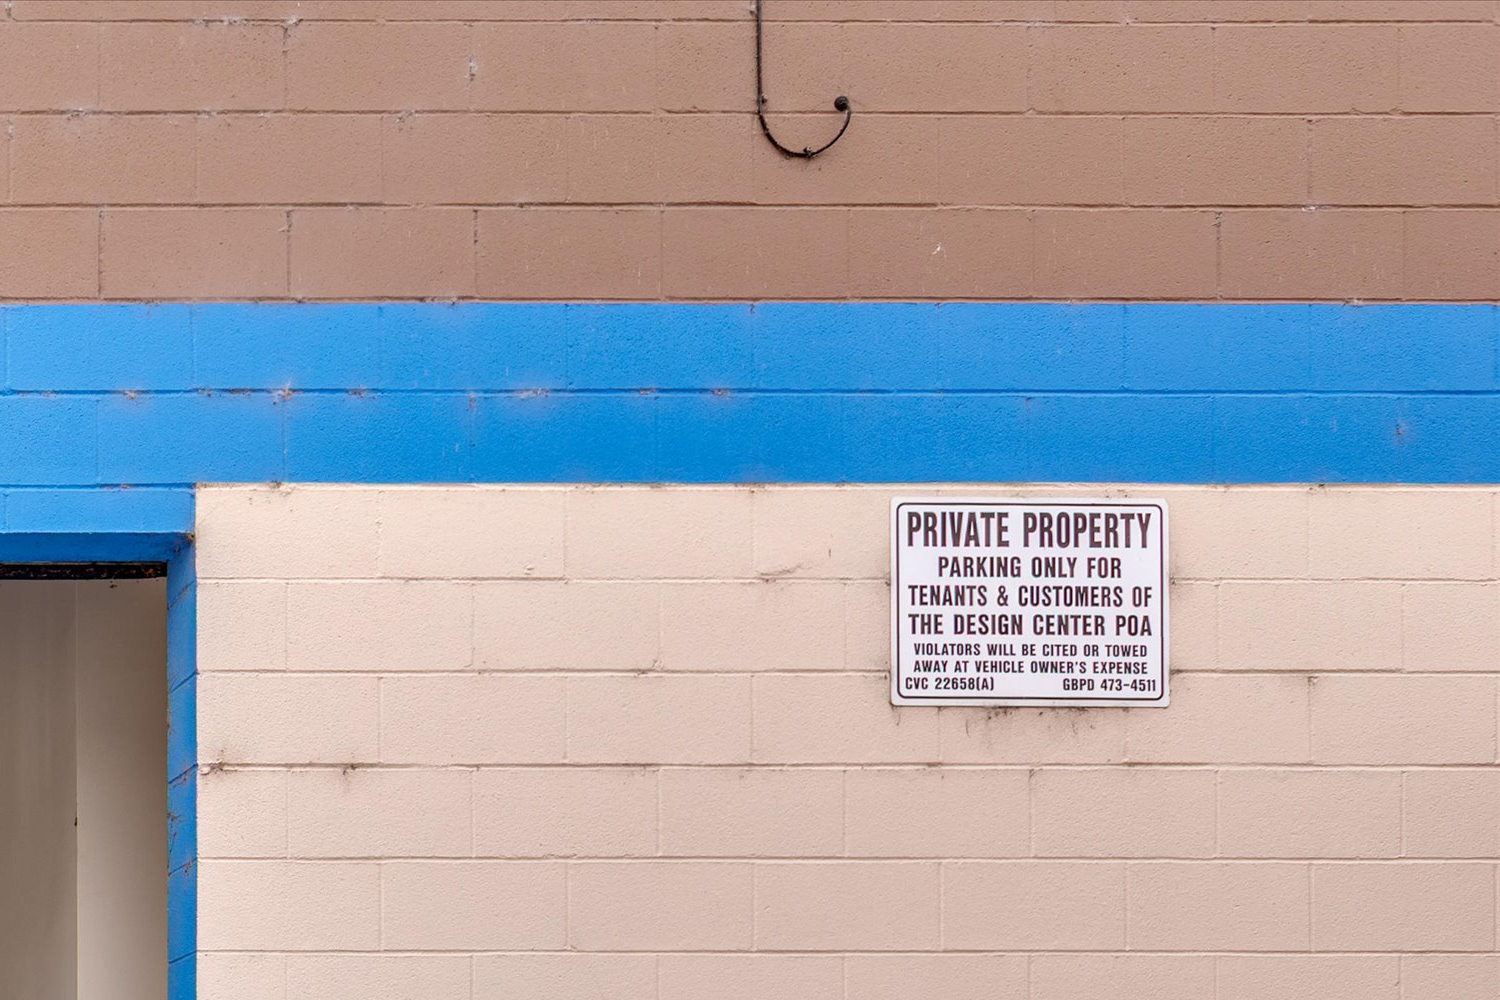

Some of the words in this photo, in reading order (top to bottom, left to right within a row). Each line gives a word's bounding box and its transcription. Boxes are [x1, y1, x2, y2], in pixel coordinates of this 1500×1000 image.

[908, 512, 1009, 547] PRIVATE
[1024, 512, 1151, 548] PROPERTY
[939, 557, 1020, 577] PARKING
[1032, 557, 1077, 577] ONLY
[1088, 557, 1121, 578] FOR
[908, 585, 987, 606] TENANTS
[997, 586, 1008, 606] &
[1019, 586, 1122, 607] CUSTOMERS
[1133, 586, 1152, 607] OF
[908, 614, 943, 634] THE
[954, 614, 1022, 635] DESIGN
[1033, 615, 1105, 635] CENTER
[1116, 615, 1152, 636] POA
[914, 643, 980, 655] VIOLATORS
[987, 644, 1015, 656] WILL
[1022, 644, 1036, 656] BE
[1043, 644, 1077, 656] CITED
[1084, 644, 1098, 656] OR
[1105, 645, 1147, 657] TOWED
[914, 661, 948, 672] AWAY
[954, 661, 969, 672] AT
[975, 661, 1024, 673] VEHICLE
[1031, 661, 1086, 673] OWNER'S
[1093, 662, 1147, 674] EXPENSE
[906, 677, 928, 689] CVC
[935, 677, 994, 691] 22658(A)
[1063, 678, 1094, 690] GBPD
[1101, 679, 1155, 691] 473-4511
